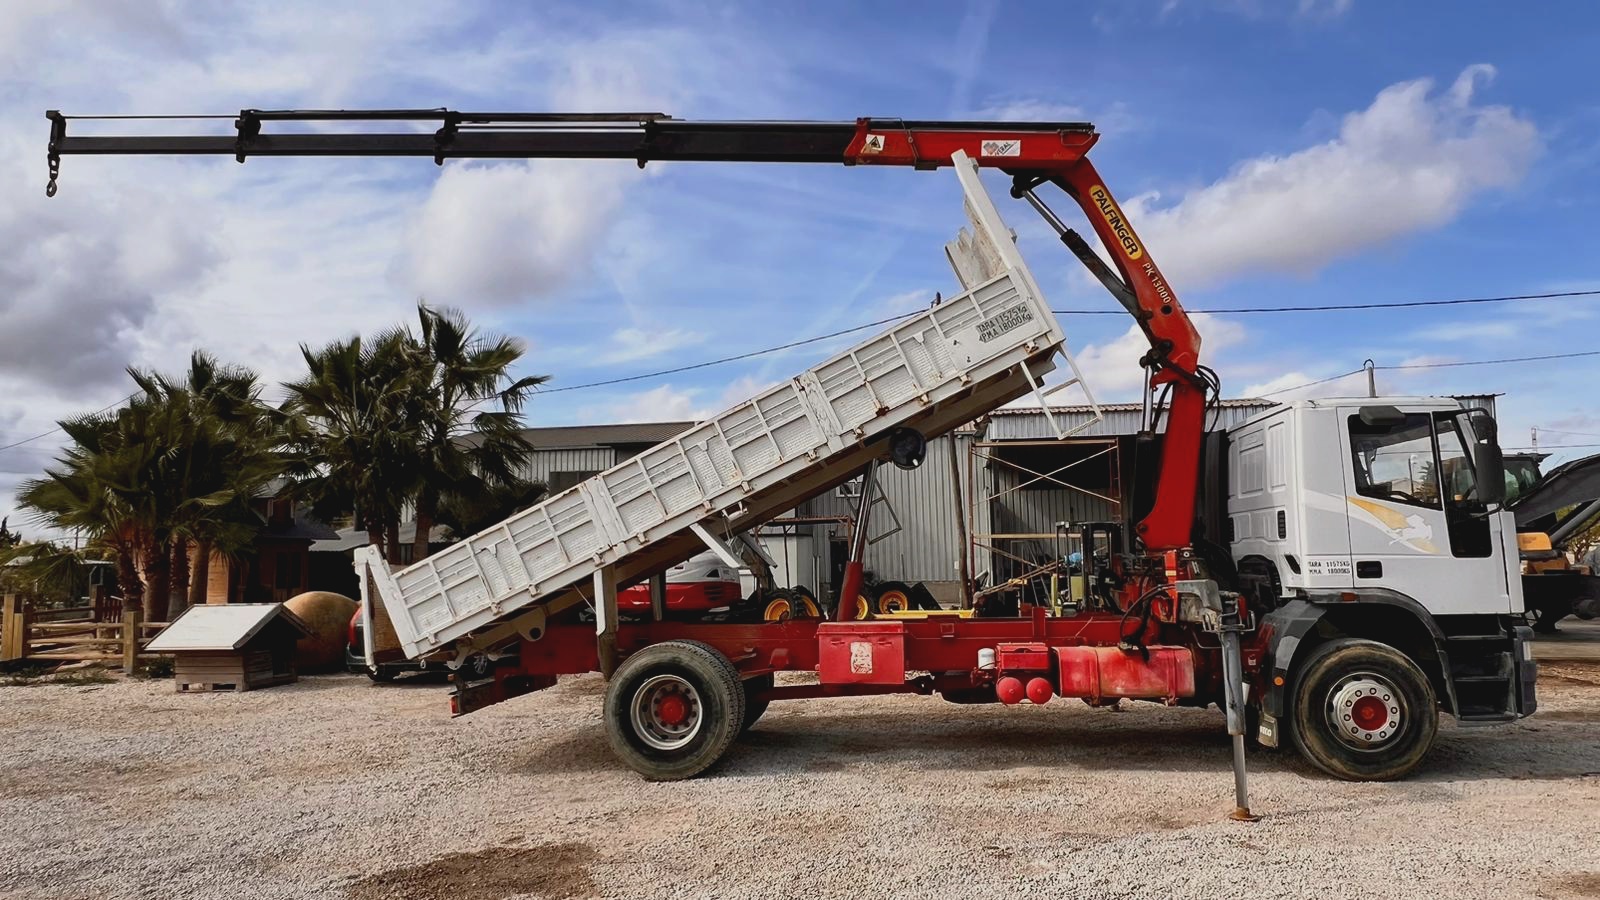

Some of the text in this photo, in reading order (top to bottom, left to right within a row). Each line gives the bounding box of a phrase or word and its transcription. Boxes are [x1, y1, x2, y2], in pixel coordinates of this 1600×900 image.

[1092, 189, 1139, 256] PALFINGER
[1143, 262, 1172, 304] PK 13000
[977, 320, 996, 333] TARA
